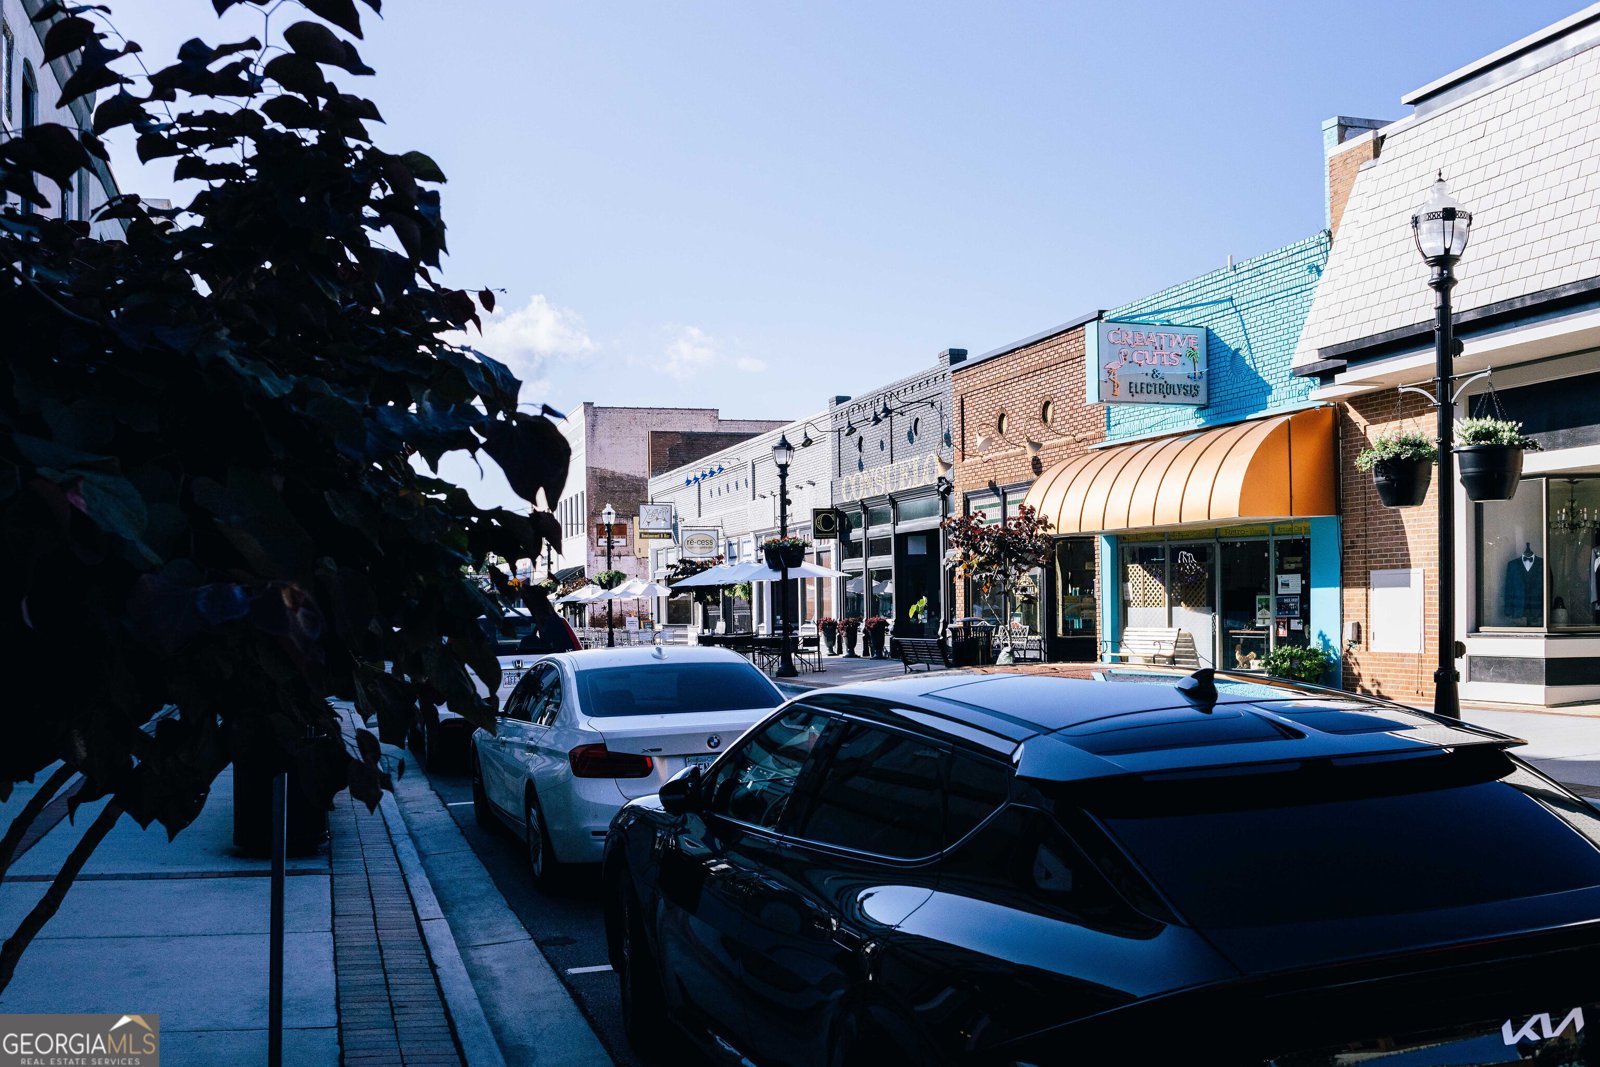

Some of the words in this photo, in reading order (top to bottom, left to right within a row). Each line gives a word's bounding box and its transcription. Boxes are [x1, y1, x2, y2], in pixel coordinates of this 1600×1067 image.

[1107, 329, 1199, 349] CREATIVE
[1132, 350, 1182, 367] CUTS
[1151, 368, 1162, 380] &
[1128, 381, 1201, 398] ELECTROLYSIS
[841, 453, 939, 502] CONSUELO
